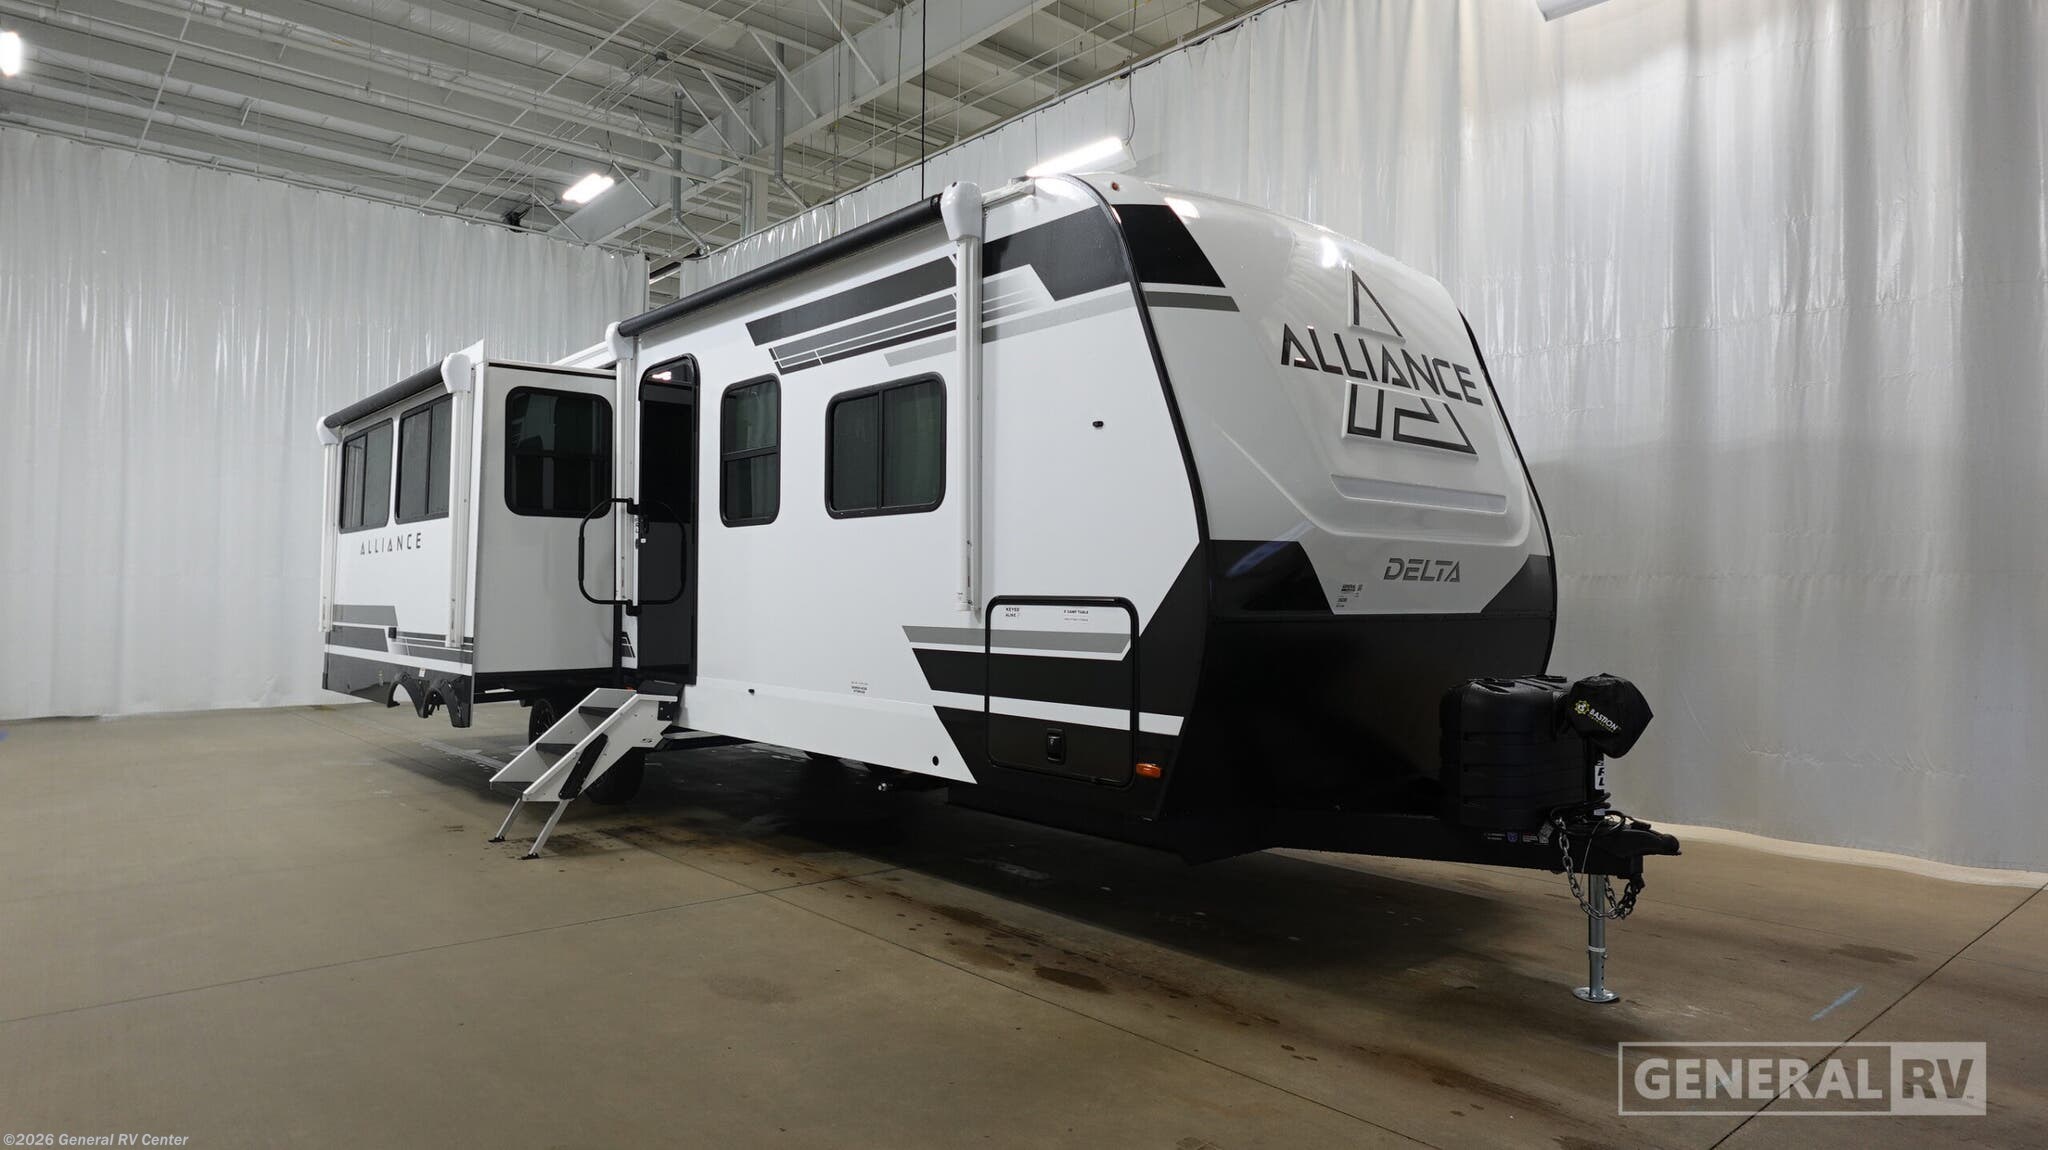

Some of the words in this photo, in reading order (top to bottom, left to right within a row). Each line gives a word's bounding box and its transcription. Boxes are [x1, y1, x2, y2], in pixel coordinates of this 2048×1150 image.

[1281, 323, 1483, 406] ALLIANCE
[360, 532, 422, 555] ALLIANCE
[1383, 557, 1461, 583] DELTA
[1589, 708, 1619, 731] BASTION
